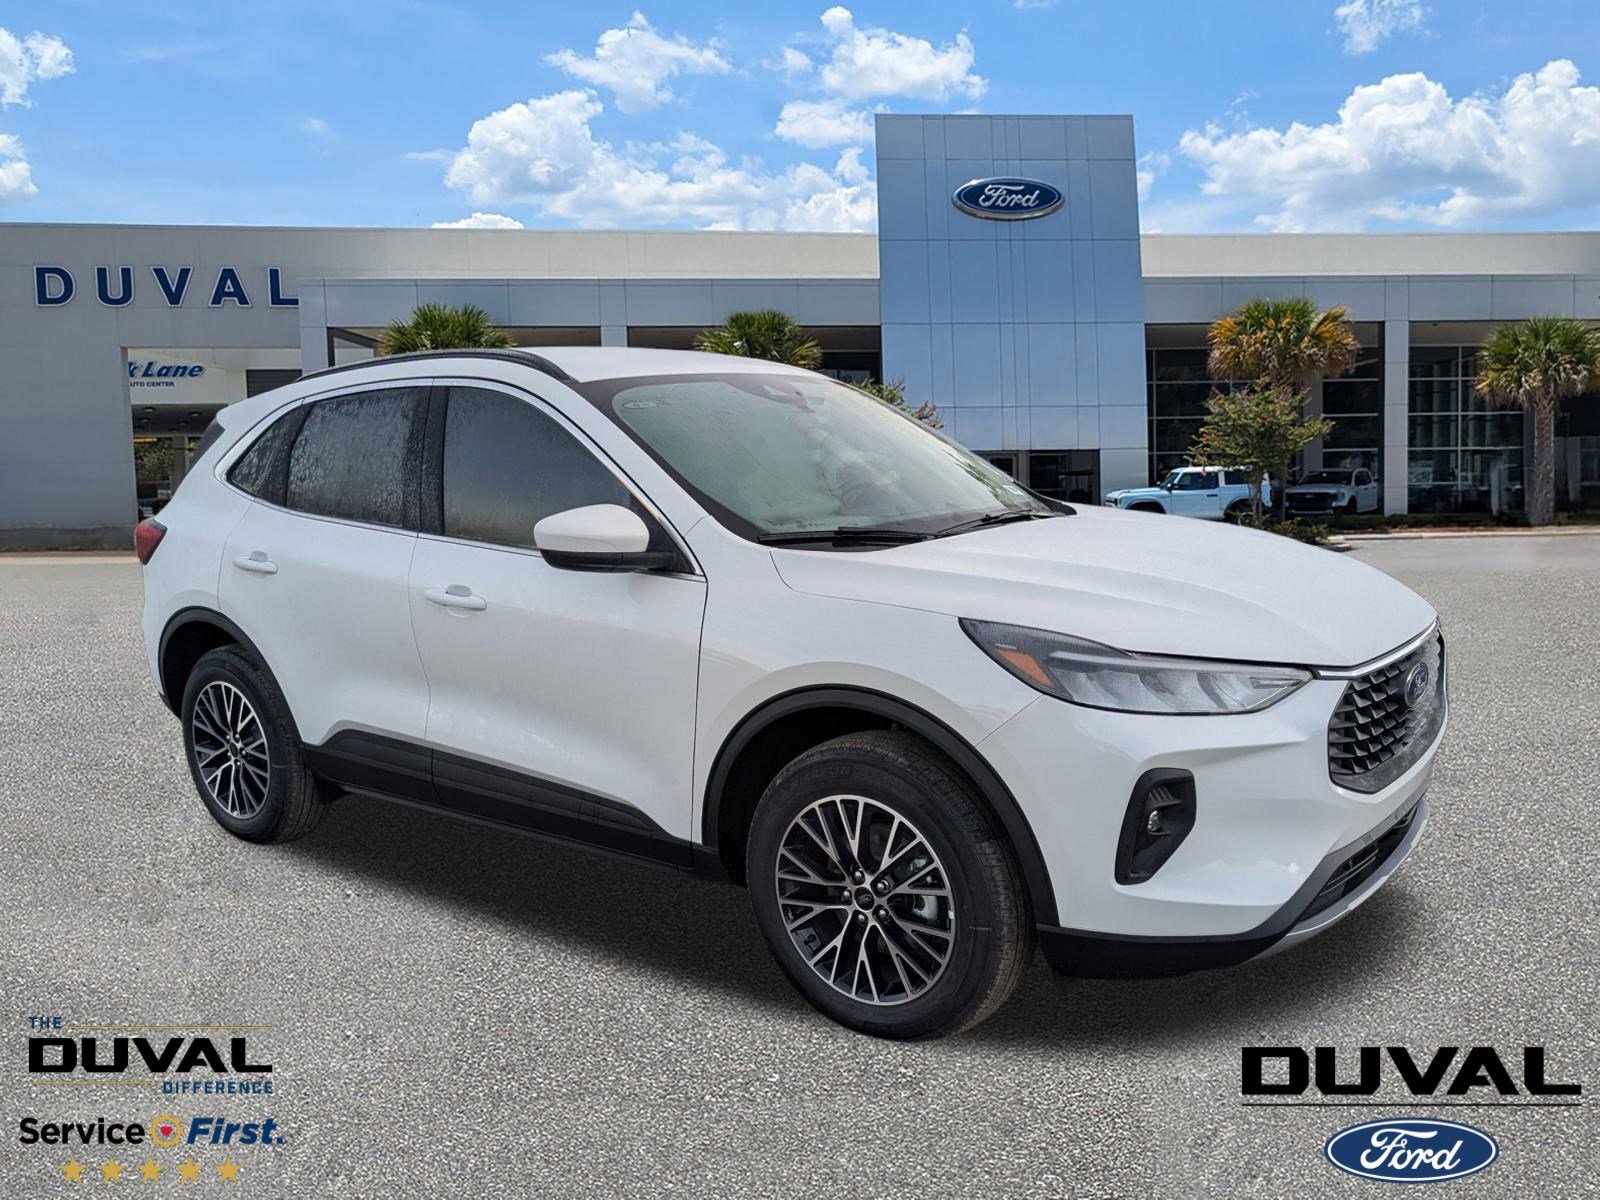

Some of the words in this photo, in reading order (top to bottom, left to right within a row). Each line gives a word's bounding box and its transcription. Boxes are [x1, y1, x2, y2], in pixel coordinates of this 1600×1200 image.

[978, 184, 1040, 207] Ford
[33, 265, 299, 308] DUVAL
[141, 361, 205, 378] Lane
